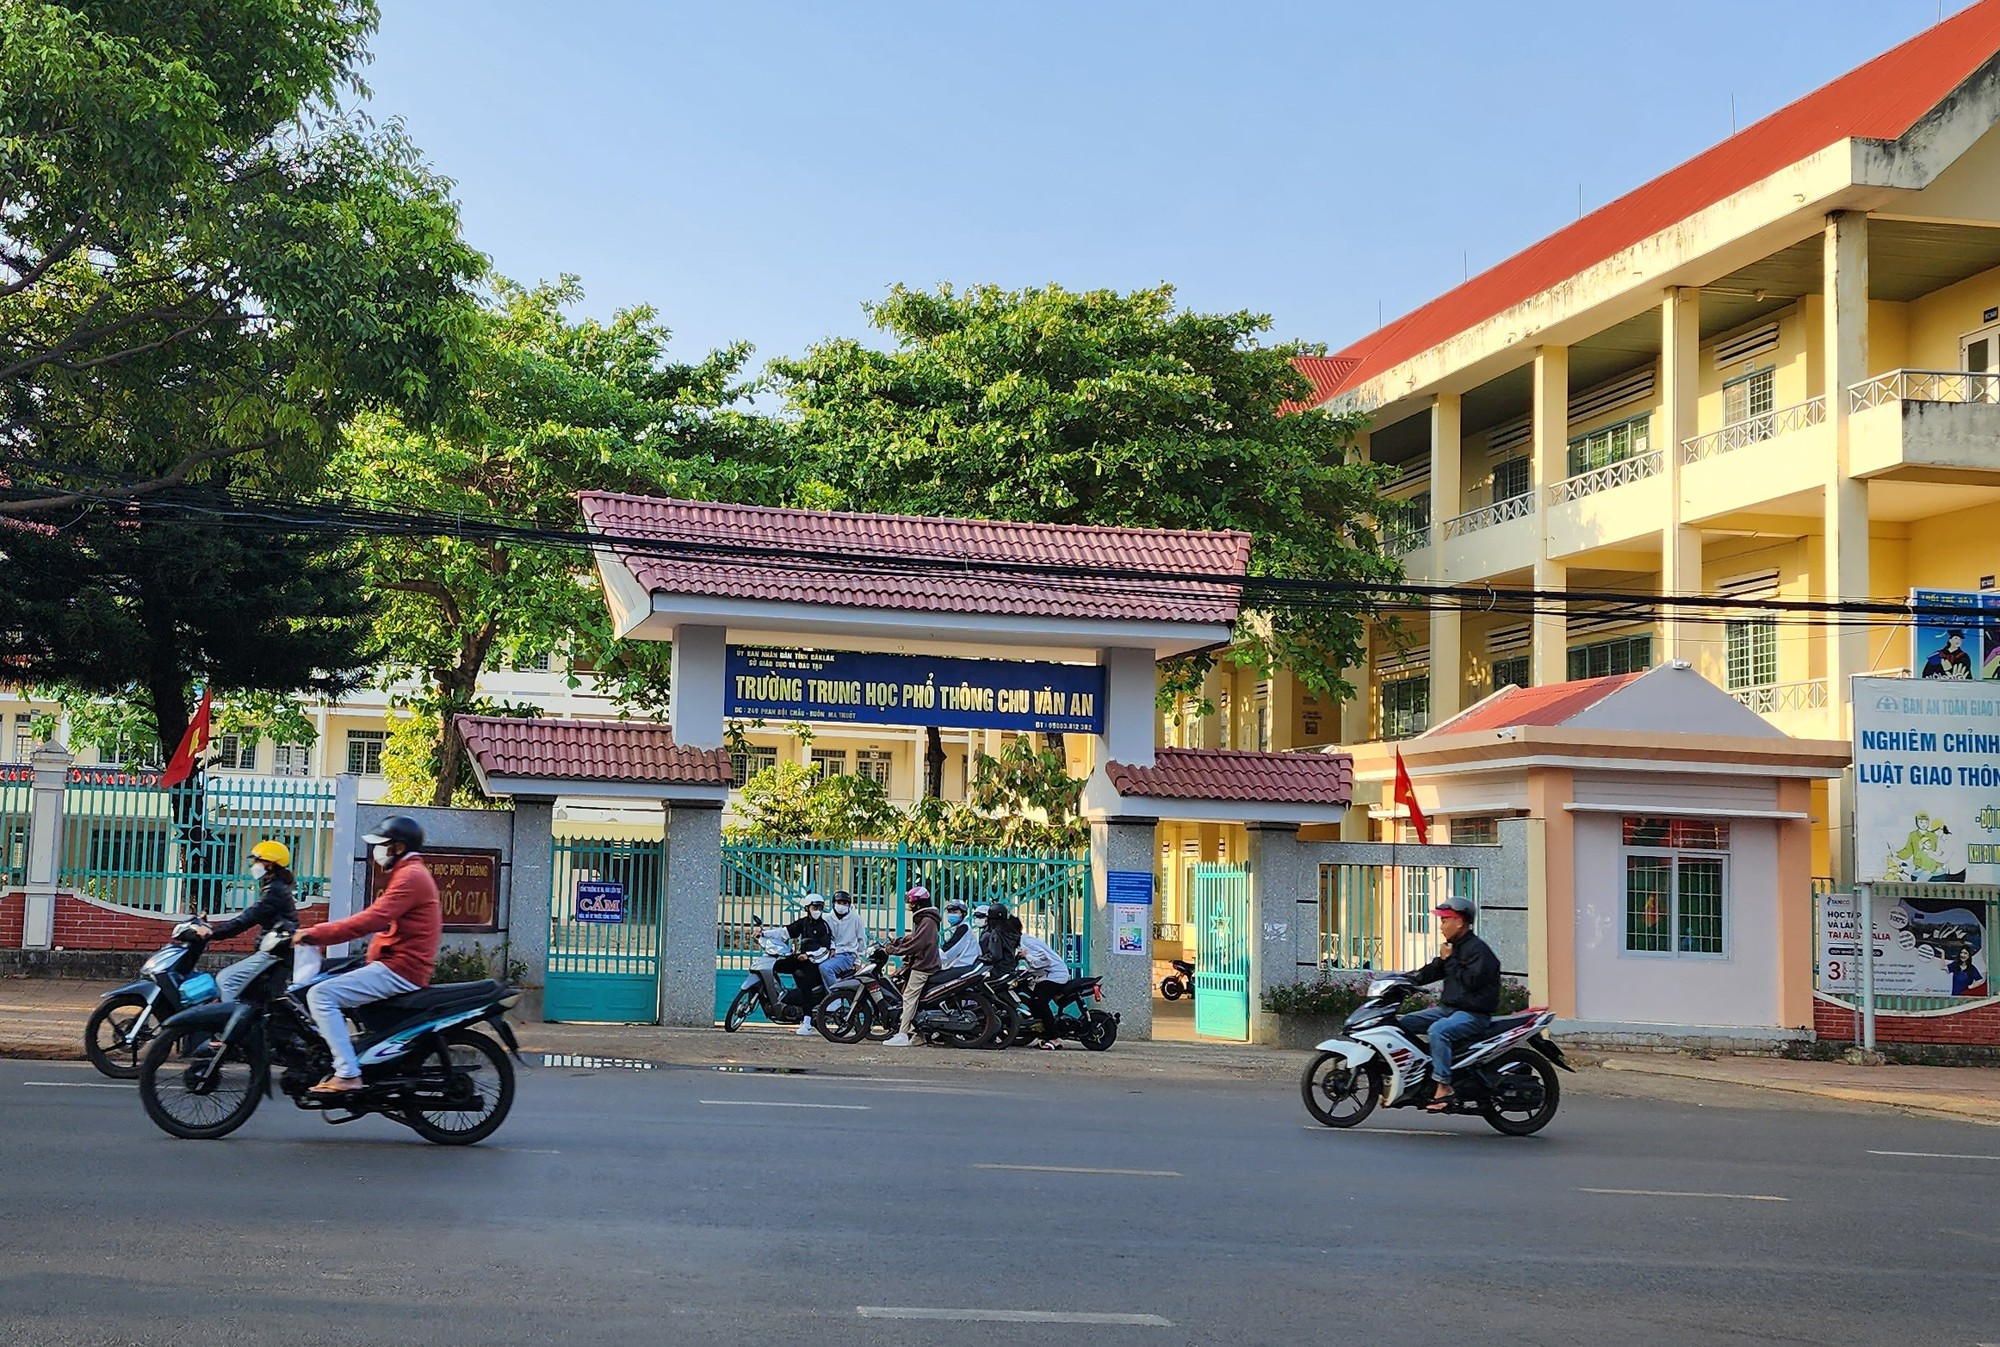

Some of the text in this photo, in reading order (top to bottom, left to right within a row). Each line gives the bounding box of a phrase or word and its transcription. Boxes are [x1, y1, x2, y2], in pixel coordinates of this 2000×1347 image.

[736, 670, 1094, 718] TRƯỜNG TRUNG HỌC PHỔ THÔNG CHU VĂN AN
[1902, 698, 1924, 714] BAN
[1926, 698, 1940, 716] AN
[1970, 700, 1993, 717] GIAO
[1862, 728, 2000, 754] NGHIÊM CHỈNH
[1860, 760, 1904, 788] LUẬT
[1910, 765, 1952, 786] GIAO
[1968, 844, 1982, 864] KHI
[434, 863, 449, 880] HỌC
[450, 859, 464, 876] PHỔ
[580, 894, 620, 912] CẤM
[1828, 911, 1846, 919] HỌC
[1828, 931, 1841, 940] TẠI
[1828, 961, 1841, 980] 3
